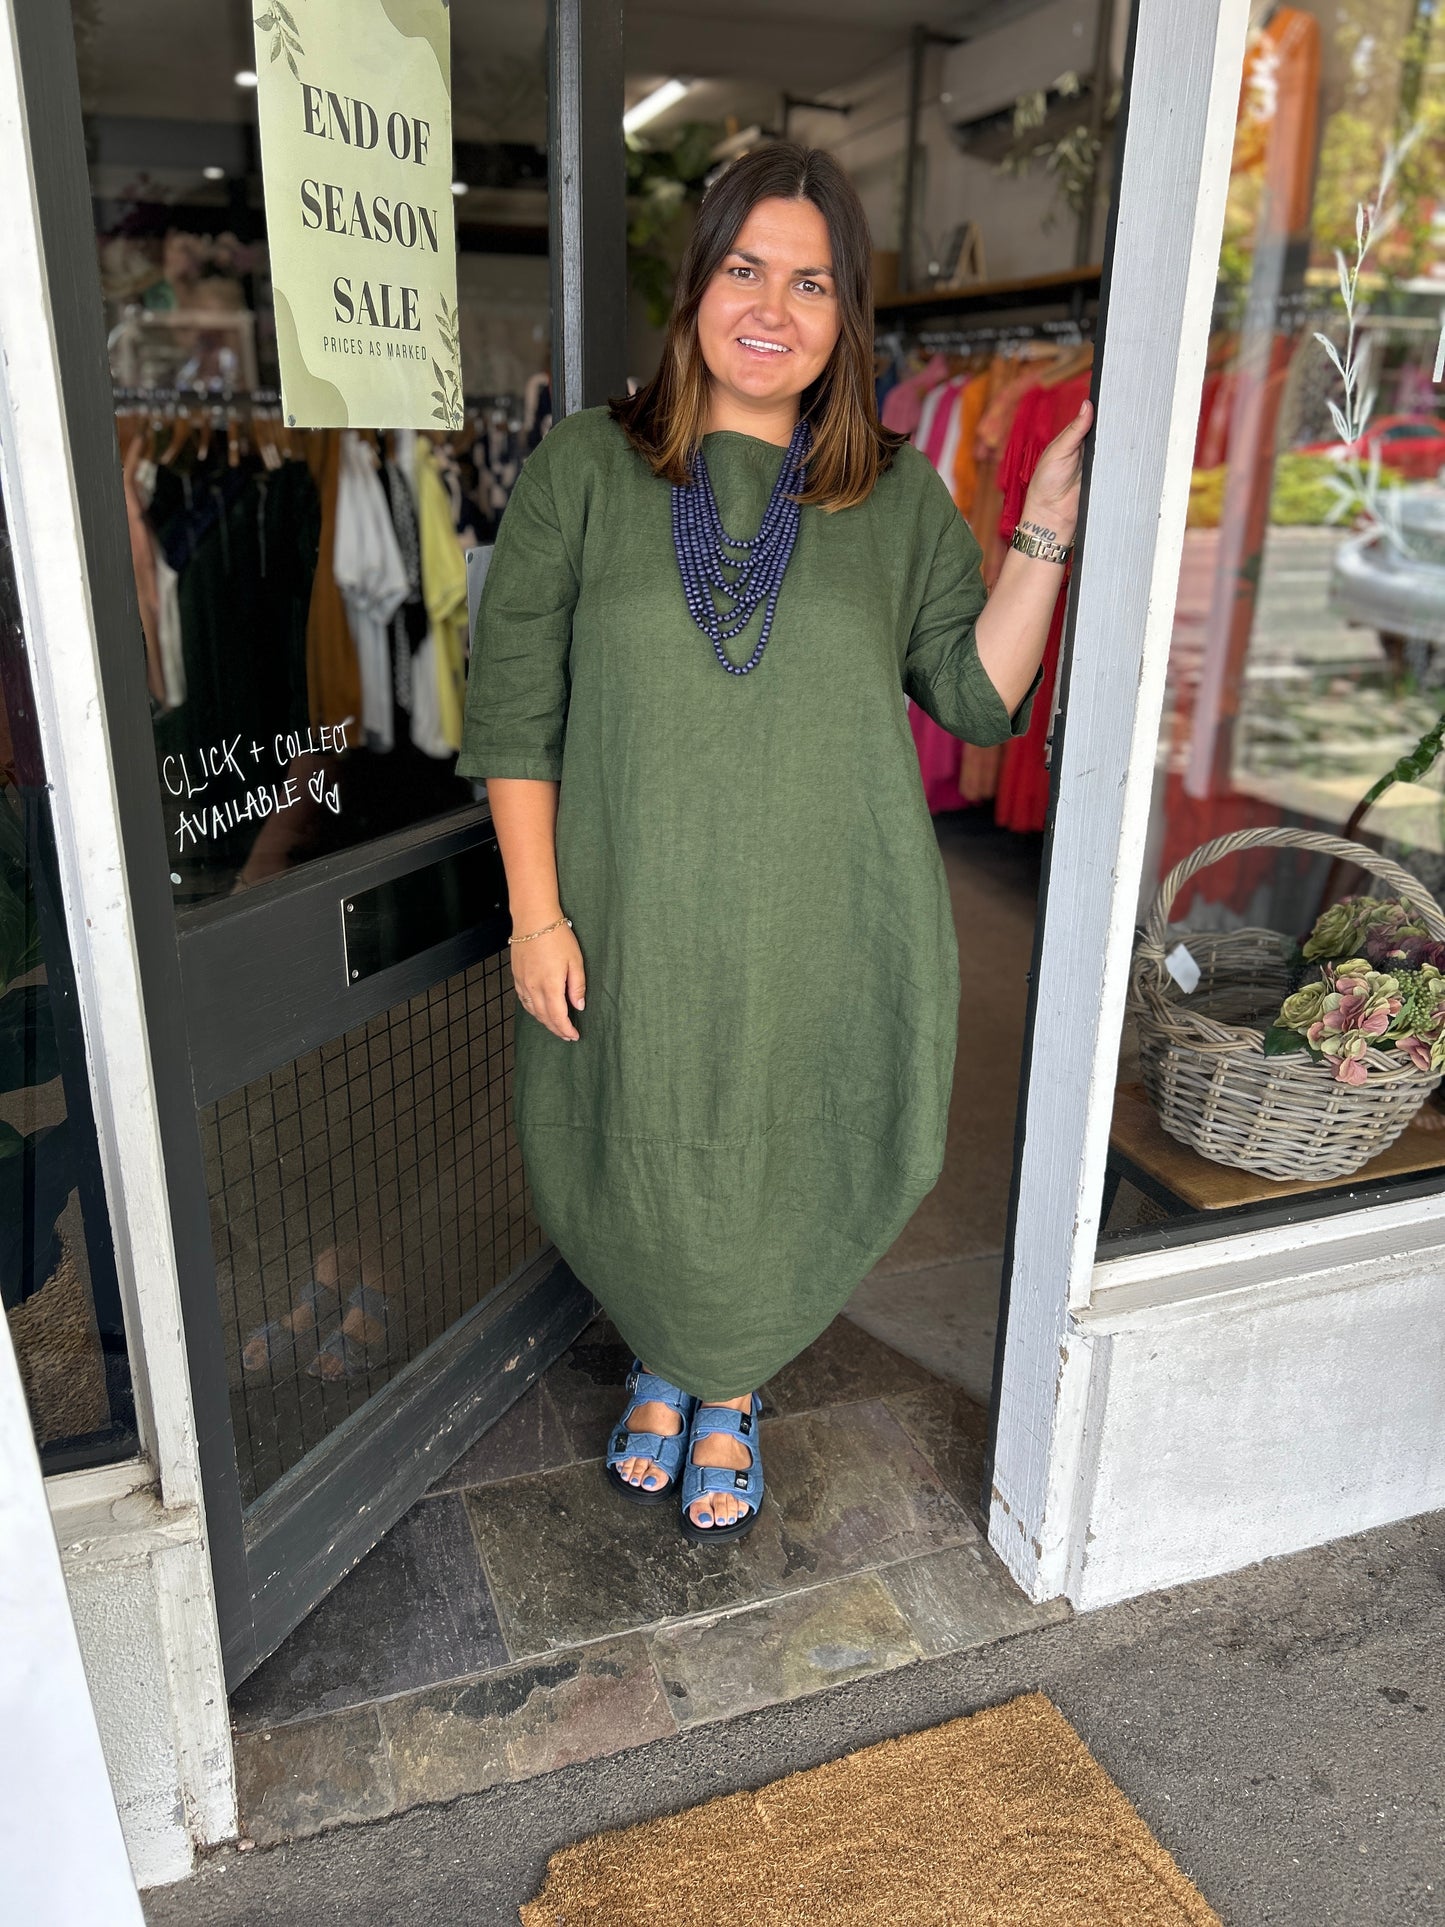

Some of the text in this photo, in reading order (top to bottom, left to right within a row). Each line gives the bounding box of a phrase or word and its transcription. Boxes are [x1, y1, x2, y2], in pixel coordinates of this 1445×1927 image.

[300, 82, 430, 166] END OF
[300, 178, 439, 254] SEASON
[333, 276, 421, 332] SALE
[323, 336, 427, 361] PRICES AS MARKED
[163, 733, 246, 799] CLICK
[274, 716, 354, 766] COLLECT
[174, 777, 302, 853] AVAILABLE
